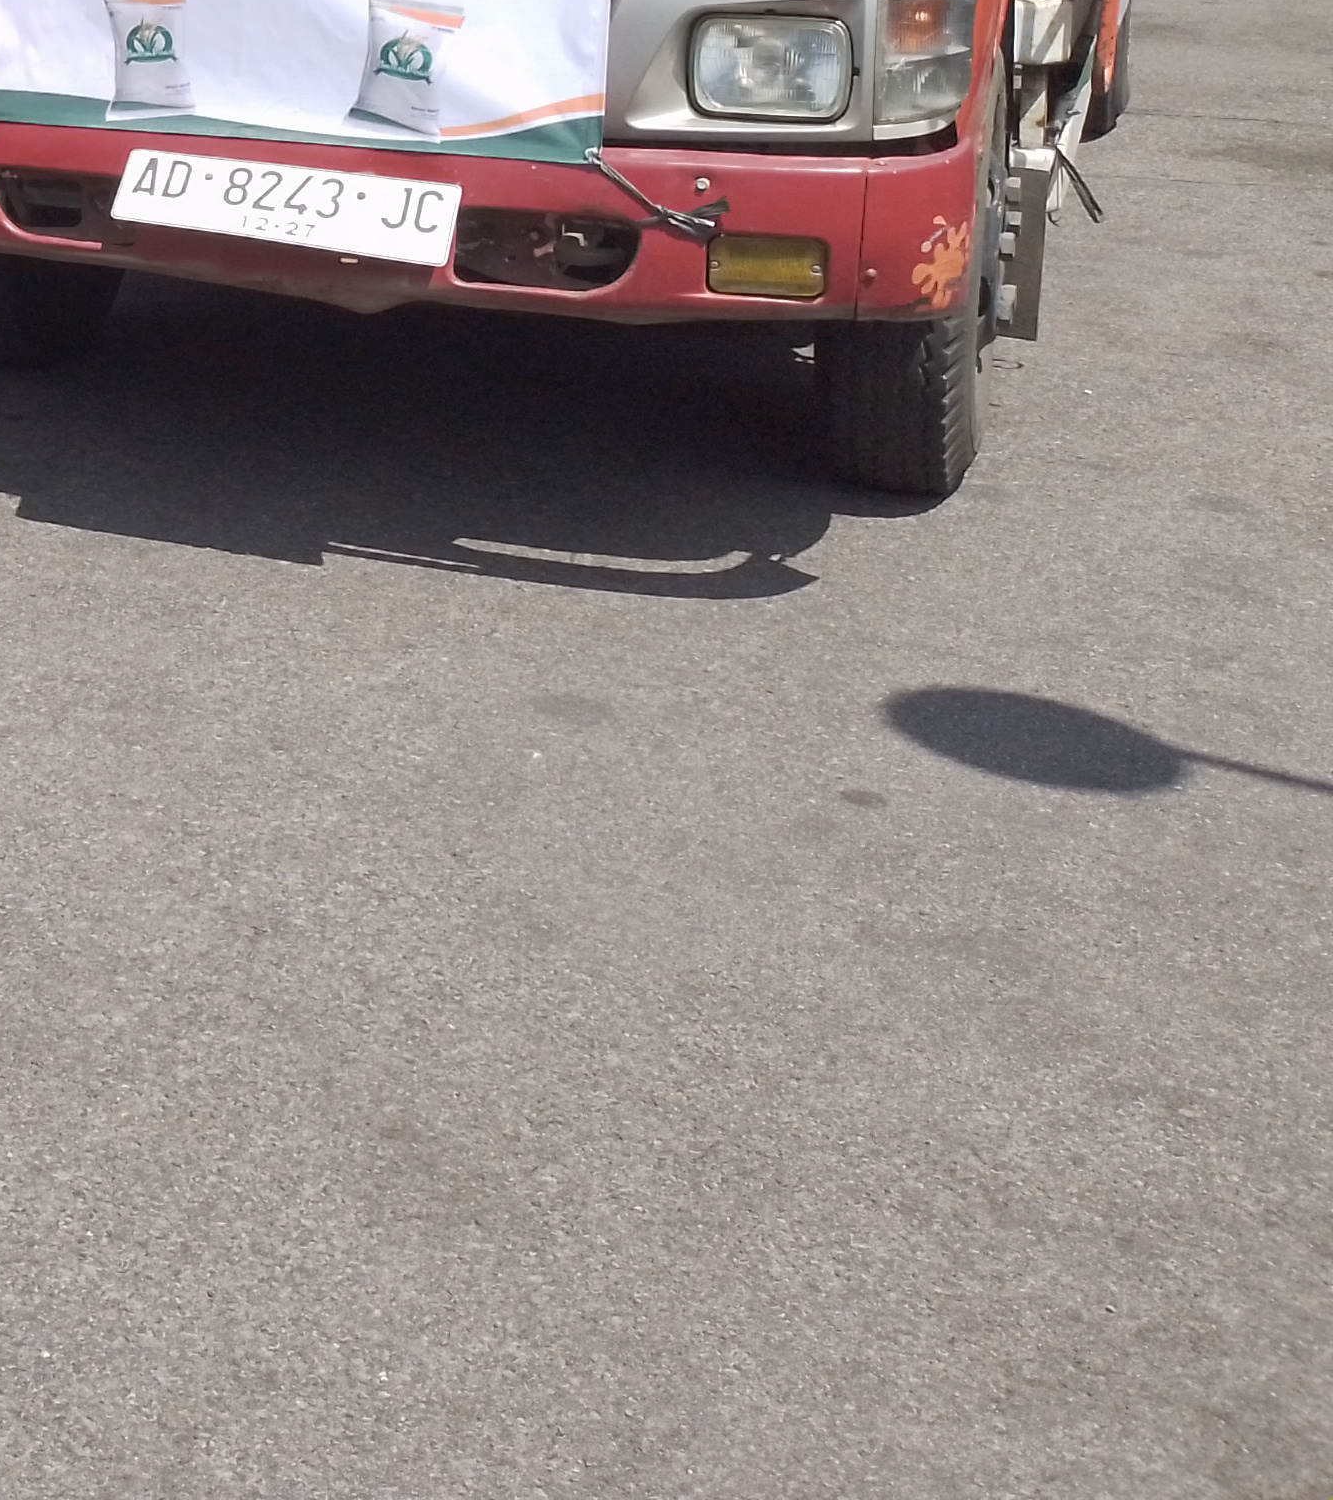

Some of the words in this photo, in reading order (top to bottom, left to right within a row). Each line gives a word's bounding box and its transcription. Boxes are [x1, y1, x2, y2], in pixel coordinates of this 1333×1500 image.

[132, 157, 193, 199] AD
[222, 167, 344, 219] 8243
[381, 187, 444, 233] JC
